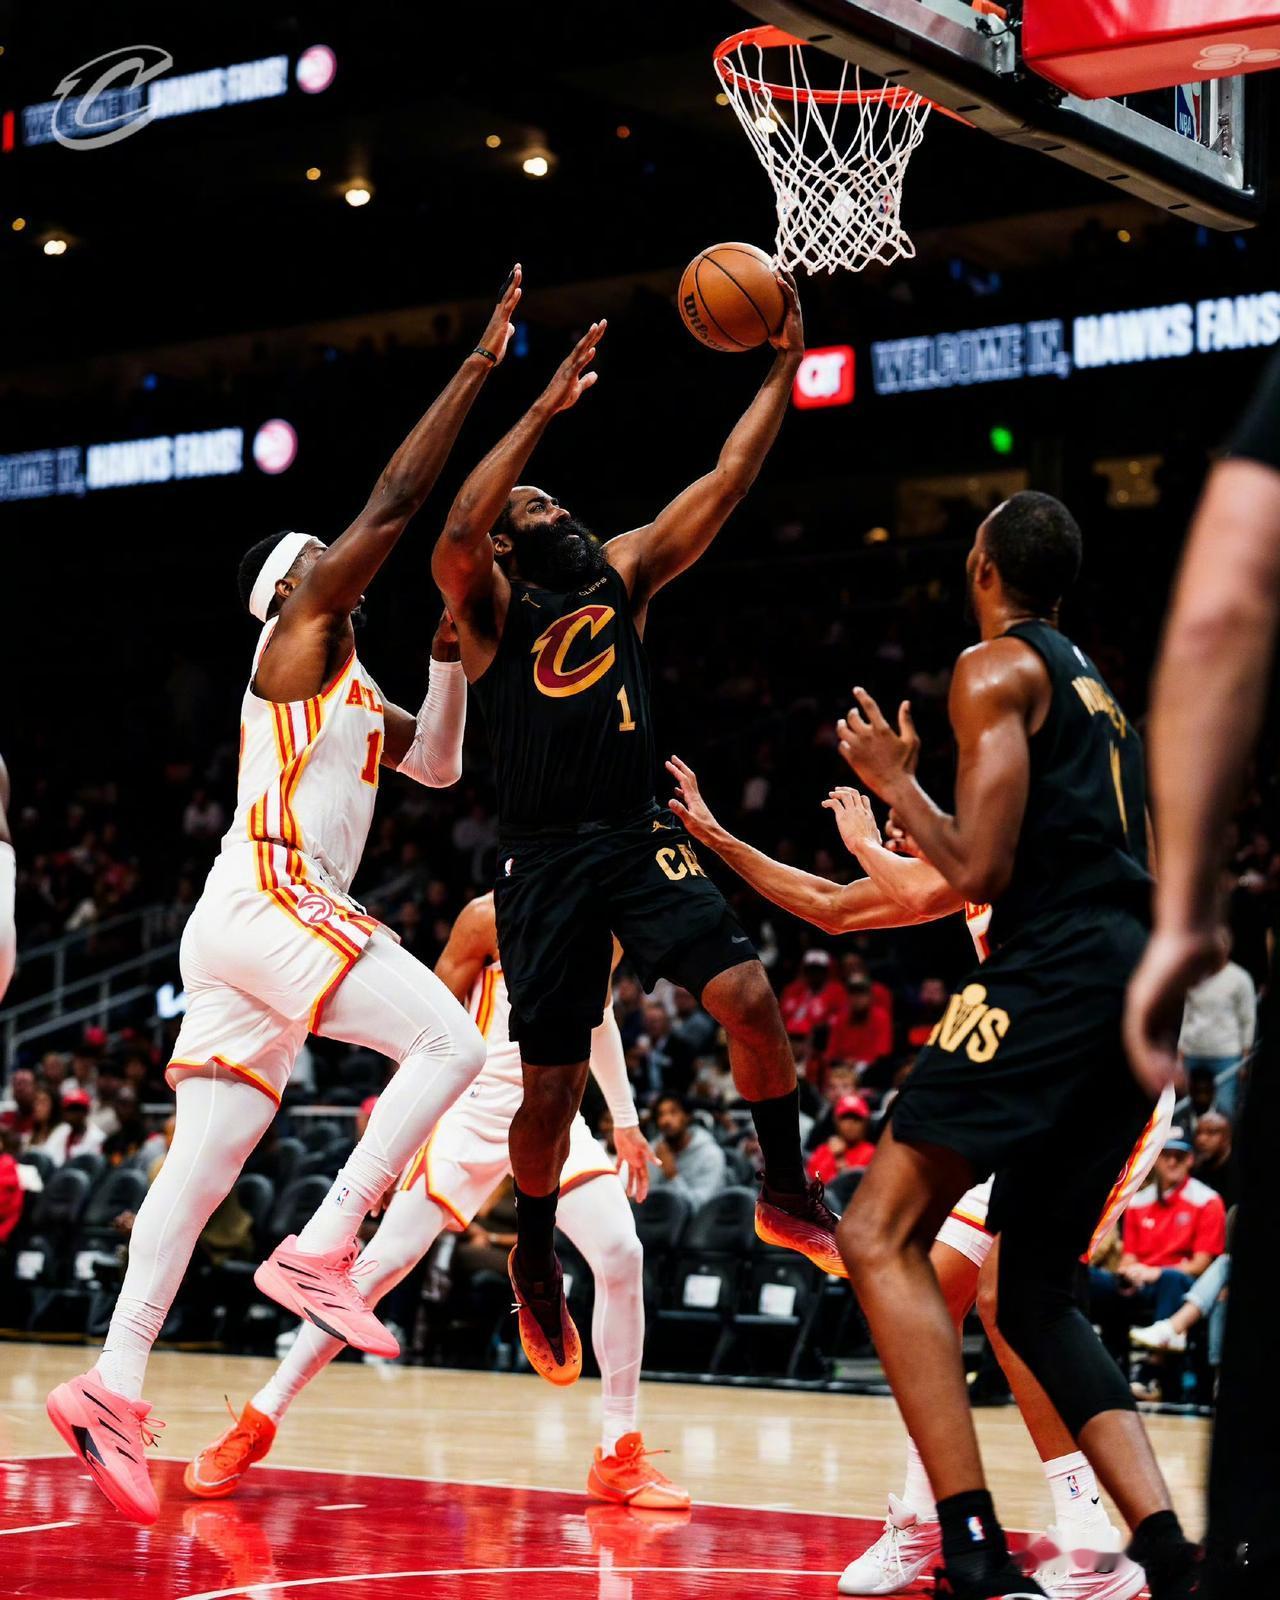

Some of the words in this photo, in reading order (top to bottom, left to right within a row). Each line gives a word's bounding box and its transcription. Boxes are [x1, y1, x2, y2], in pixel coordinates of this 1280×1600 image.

[1179, 112, 1191, 135] NBA
[871, 323, 1023, 394] WELCOME
[1073, 303, 1194, 369] HAWKS
[616, 684, 636, 732] 1
